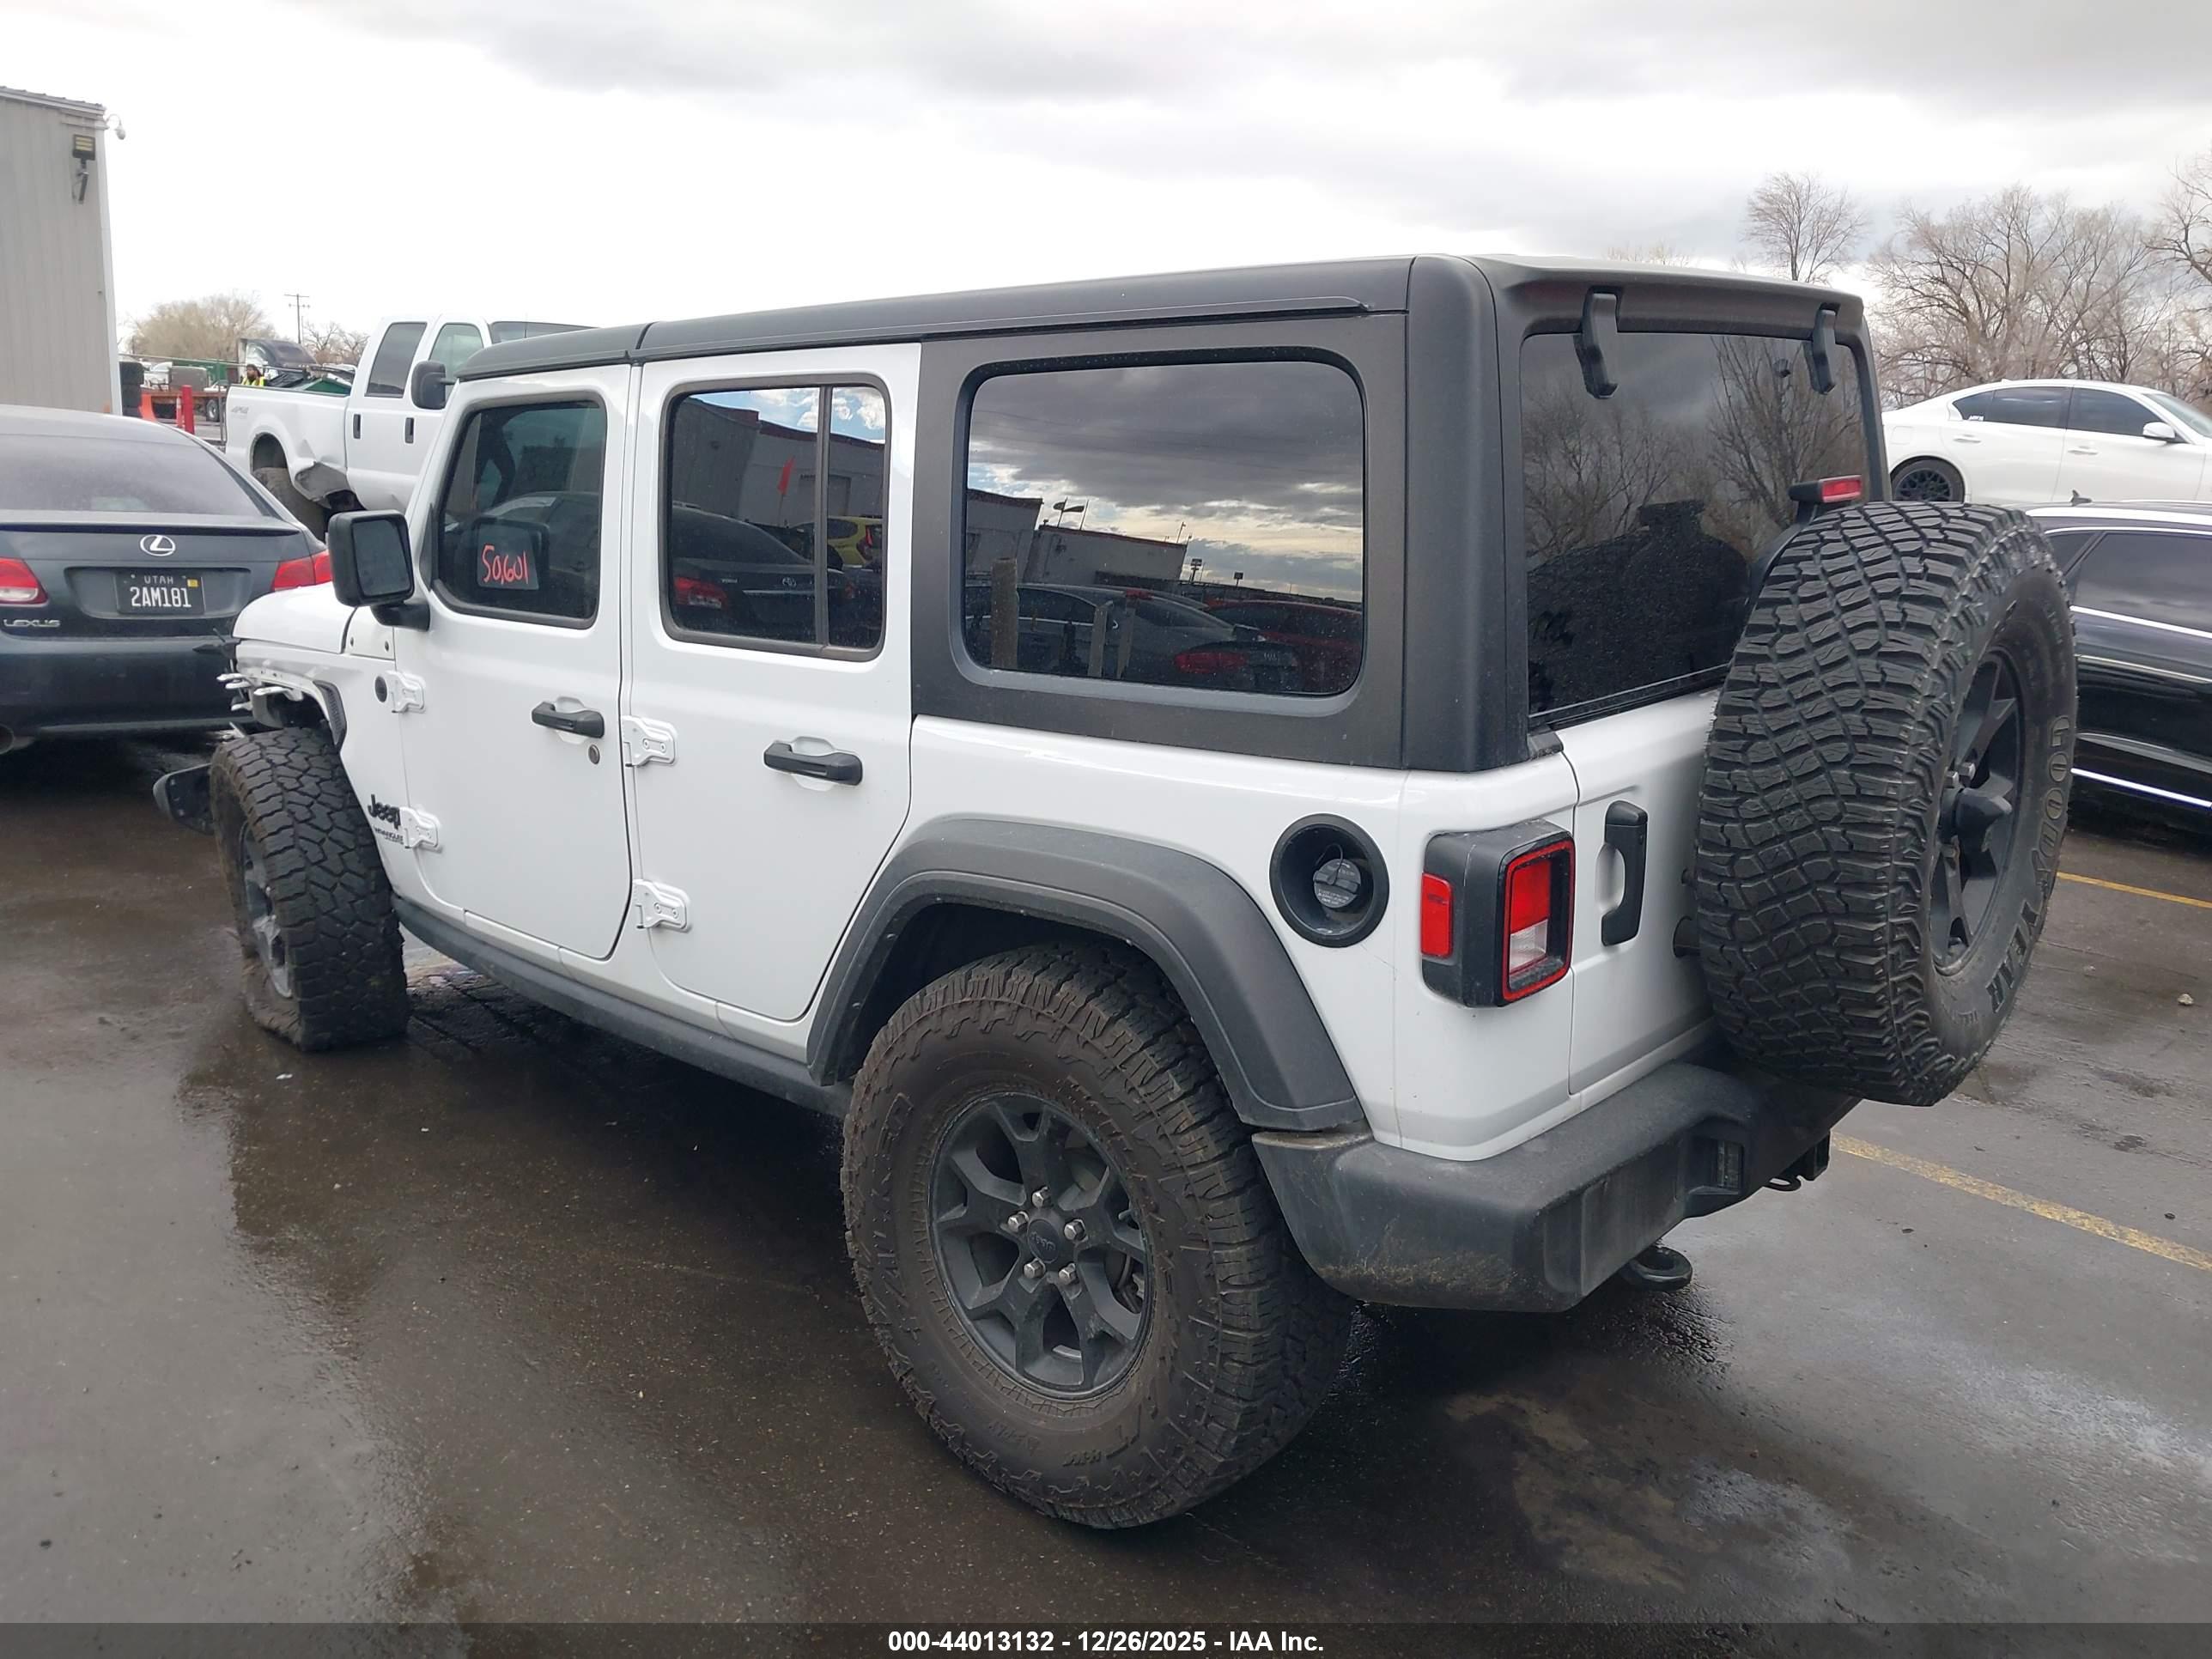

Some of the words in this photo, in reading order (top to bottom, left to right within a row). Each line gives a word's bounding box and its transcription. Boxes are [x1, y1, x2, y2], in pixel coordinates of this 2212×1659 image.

[143, 574, 174, 585] UTAH
[130, 586, 192, 608] 2AM181
[3, 618, 61, 628] LEXUS
[368, 793, 401, 830] Jeep
